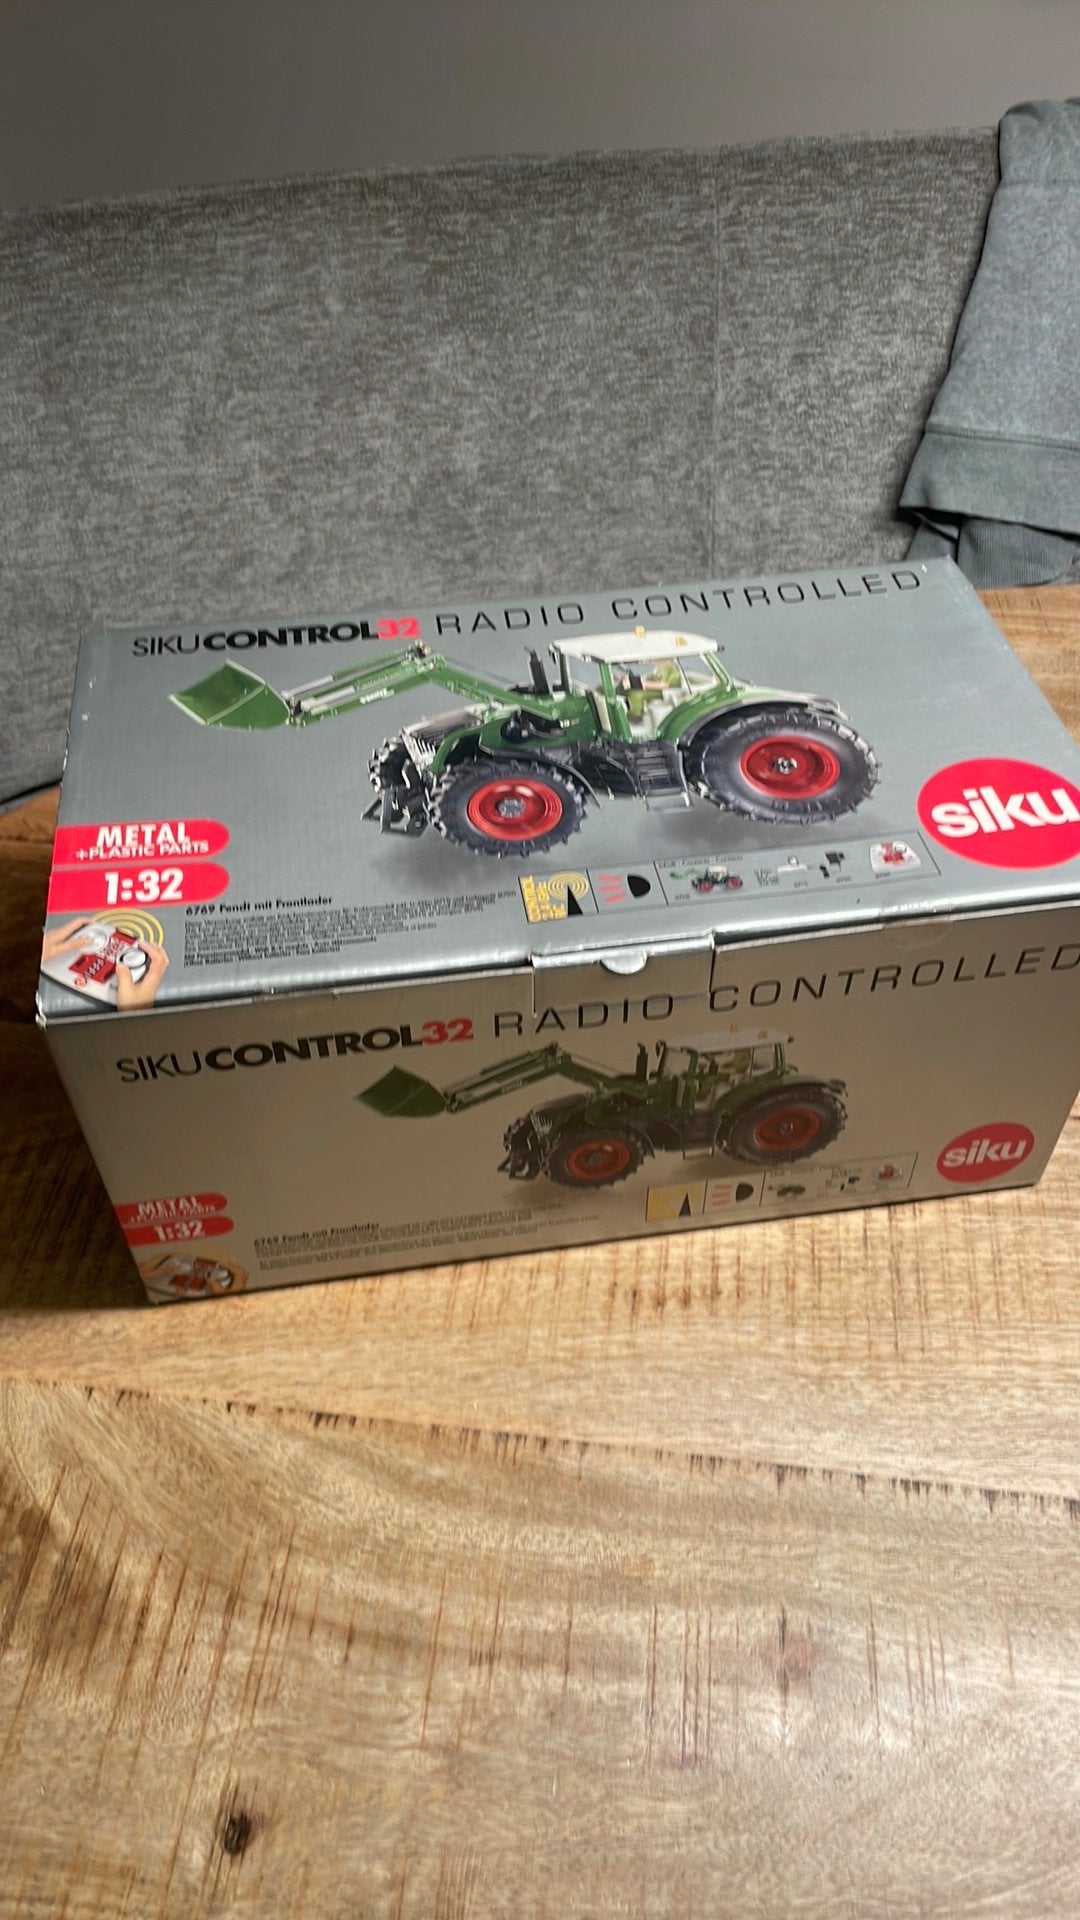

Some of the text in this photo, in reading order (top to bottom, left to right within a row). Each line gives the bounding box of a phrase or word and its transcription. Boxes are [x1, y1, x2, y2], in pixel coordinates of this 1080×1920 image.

[435, 602, 585, 636] RADIO
[611, 569, 921, 620] CONTROLLED
[930, 785, 1080, 838] siku
[96, 821, 190, 849] METAL
[160, 839, 209, 857] PARTS
[105, 867, 184, 905] 1:32
[219, 901, 250, 913] Fendt
[254, 900, 272, 911] mit
[494, 993, 674, 1038] RADIO
[709, 943, 1080, 1013] CONTROLLED
[943, 1138, 1026, 1168] siku
[154, 1219, 205, 1241] 1:32
